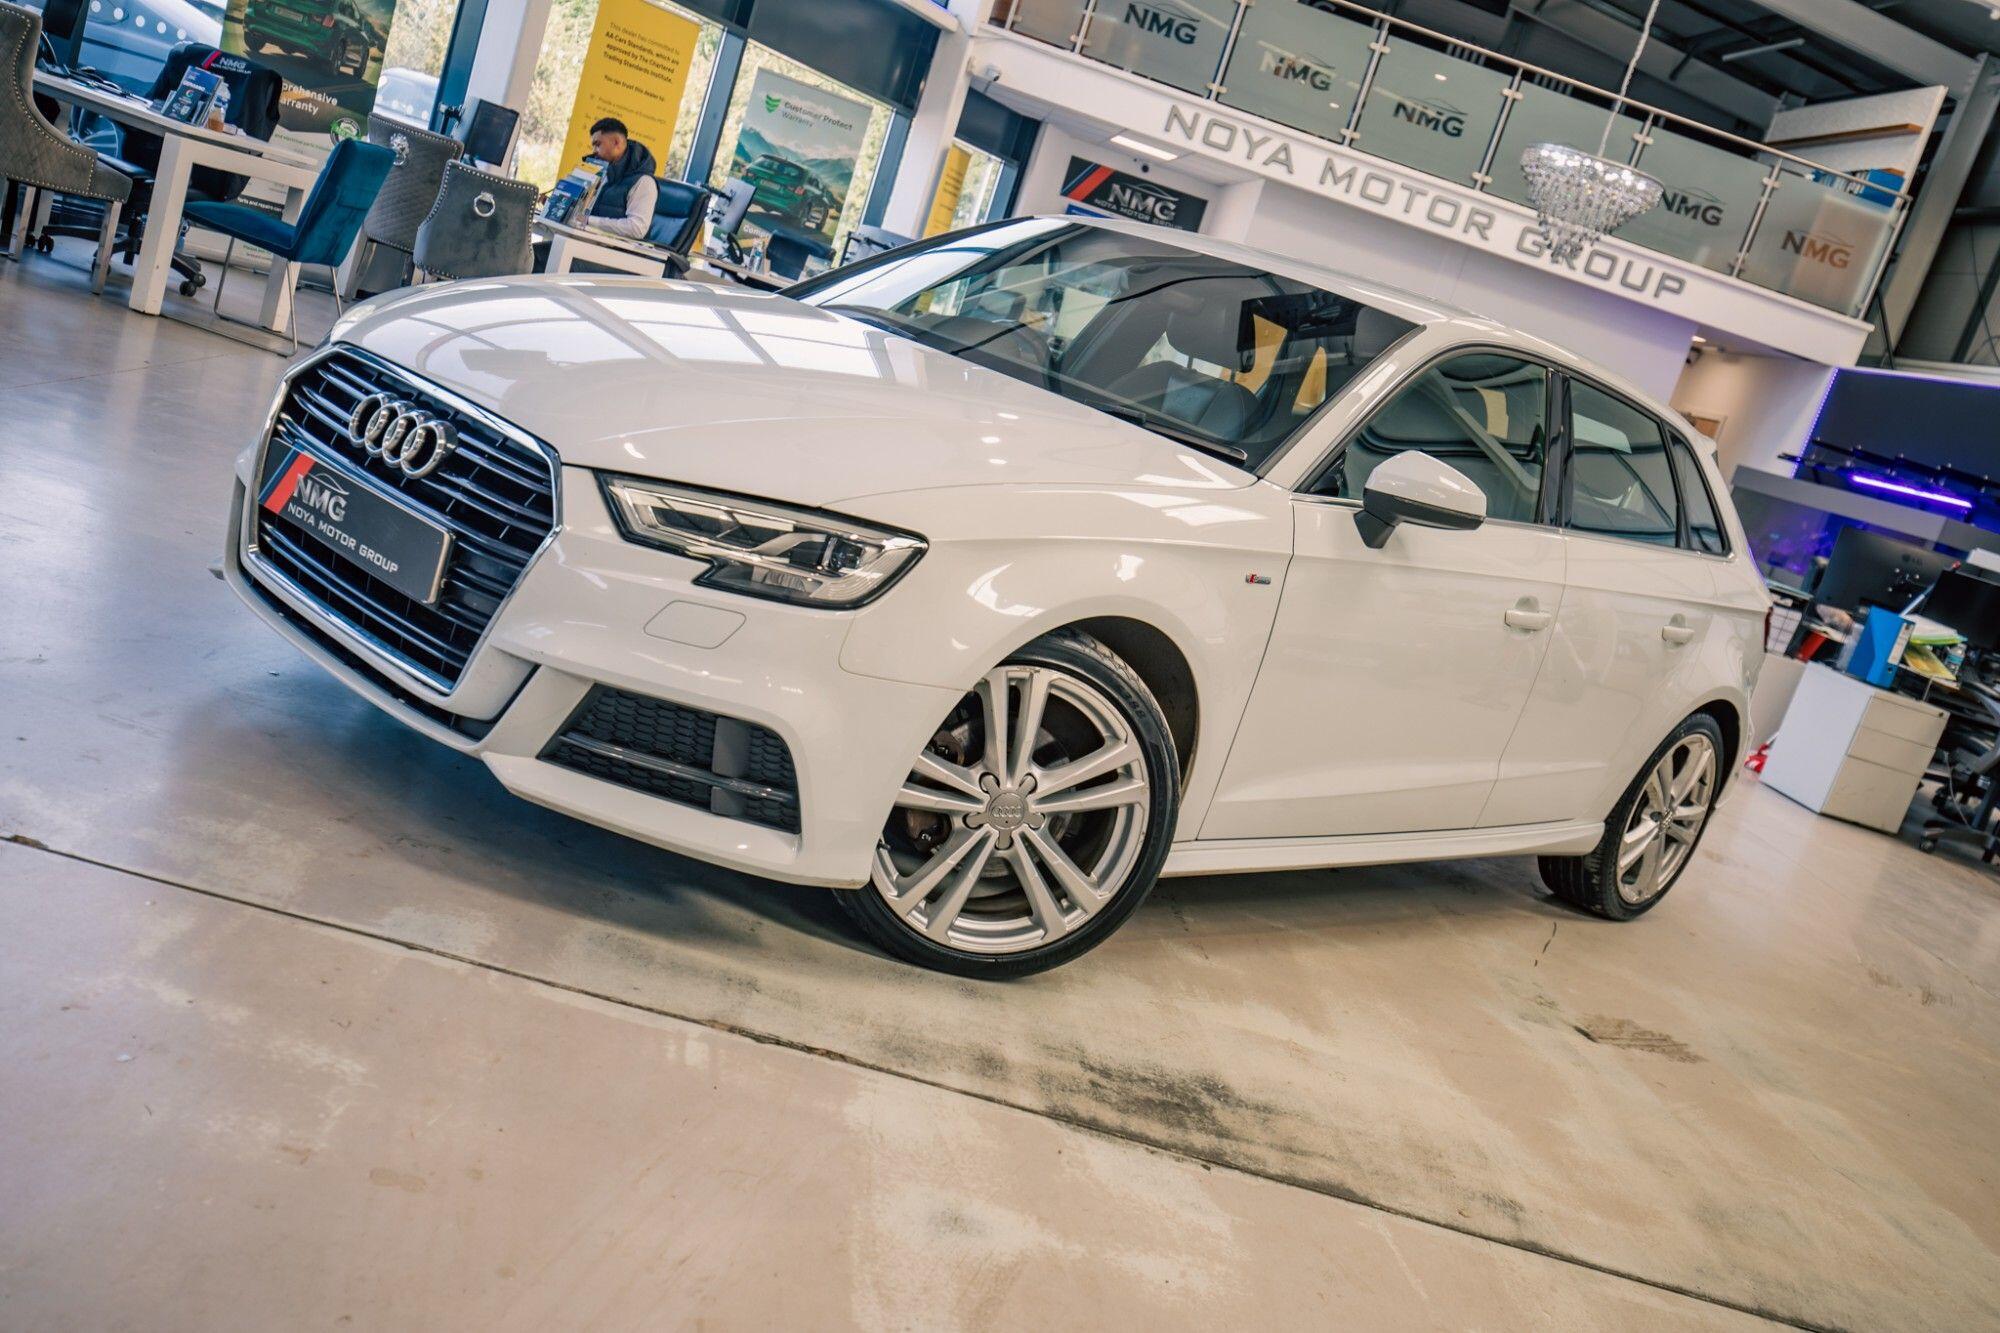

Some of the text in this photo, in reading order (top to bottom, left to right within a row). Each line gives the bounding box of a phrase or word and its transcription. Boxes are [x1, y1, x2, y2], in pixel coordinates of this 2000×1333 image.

[1124, 3, 1198, 44] NMG
[220, 57, 247, 69] NMG
[614, 34, 627, 44] Cars
[655, 52, 671, 61] which
[1260, 50, 1332, 91] NMG
[280, 96, 319, 116] arranty
[282, 82, 338, 106] prehensive
[782, 111, 814, 128] Warranty
[823, 115, 853, 131] Protect
[1393, 102, 1465, 138] NMG
[1164, 104, 1294, 175] NOYA
[1319, 157, 1496, 241] MOTOR
[1108, 183, 1177, 221] NMG
[1661, 190, 1724, 226] NMG
[1781, 230, 1851, 269] NMG
[293, 473, 347, 522] NMG
[288, 502, 399, 573] NOYA MOTOR GROUP
